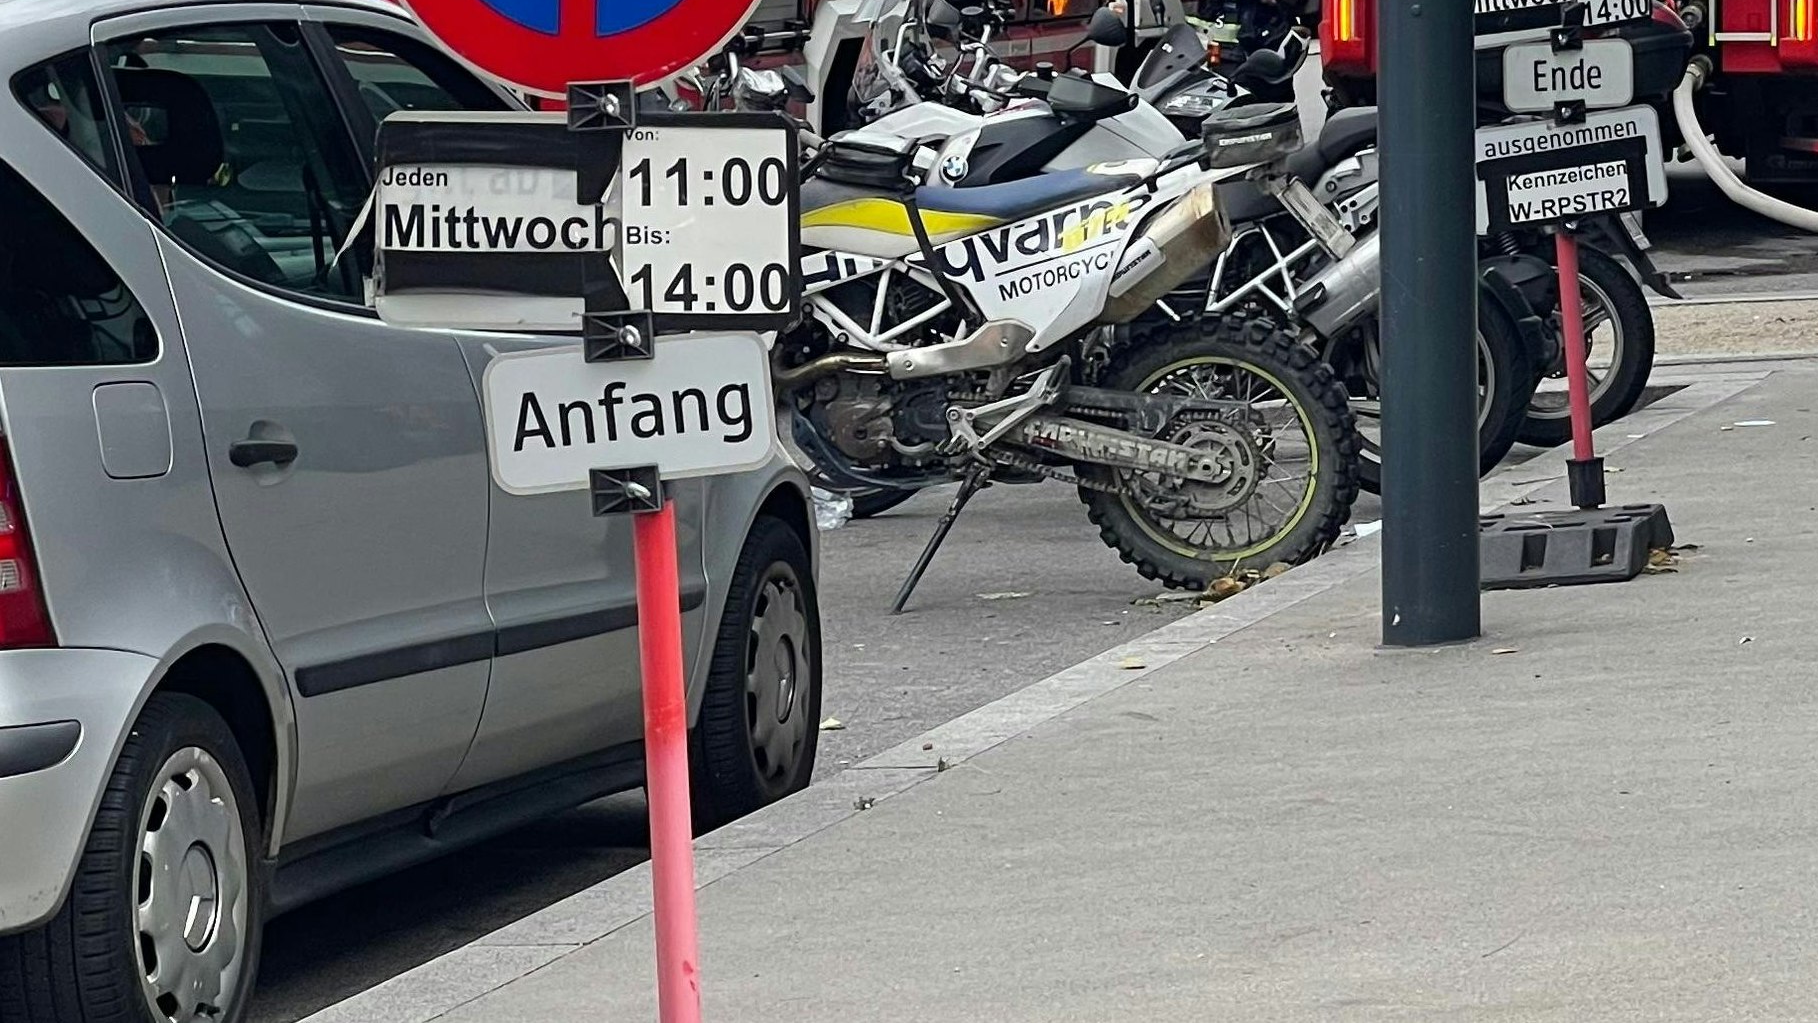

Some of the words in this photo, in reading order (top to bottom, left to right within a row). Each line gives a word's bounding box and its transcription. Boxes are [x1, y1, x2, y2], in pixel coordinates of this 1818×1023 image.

[1533, 58, 1603, 93] Ende
[624, 129, 660, 142] Von:
[1484, 119, 1639, 159] ausgenommen
[382, 167, 449, 187] Jeden
[628, 157, 788, 207] 11:00
[1508, 160, 1628, 192] Kennzeichen
[1510, 187, 1629, 222] W-RPSTR2
[383, 203, 622, 250] Mittwoch
[626, 225, 671, 245] Bis:
[630, 262, 789, 312] 14:00
[998, 249, 1116, 303] MOTORCYC
[512, 380, 754, 453] Anfang
